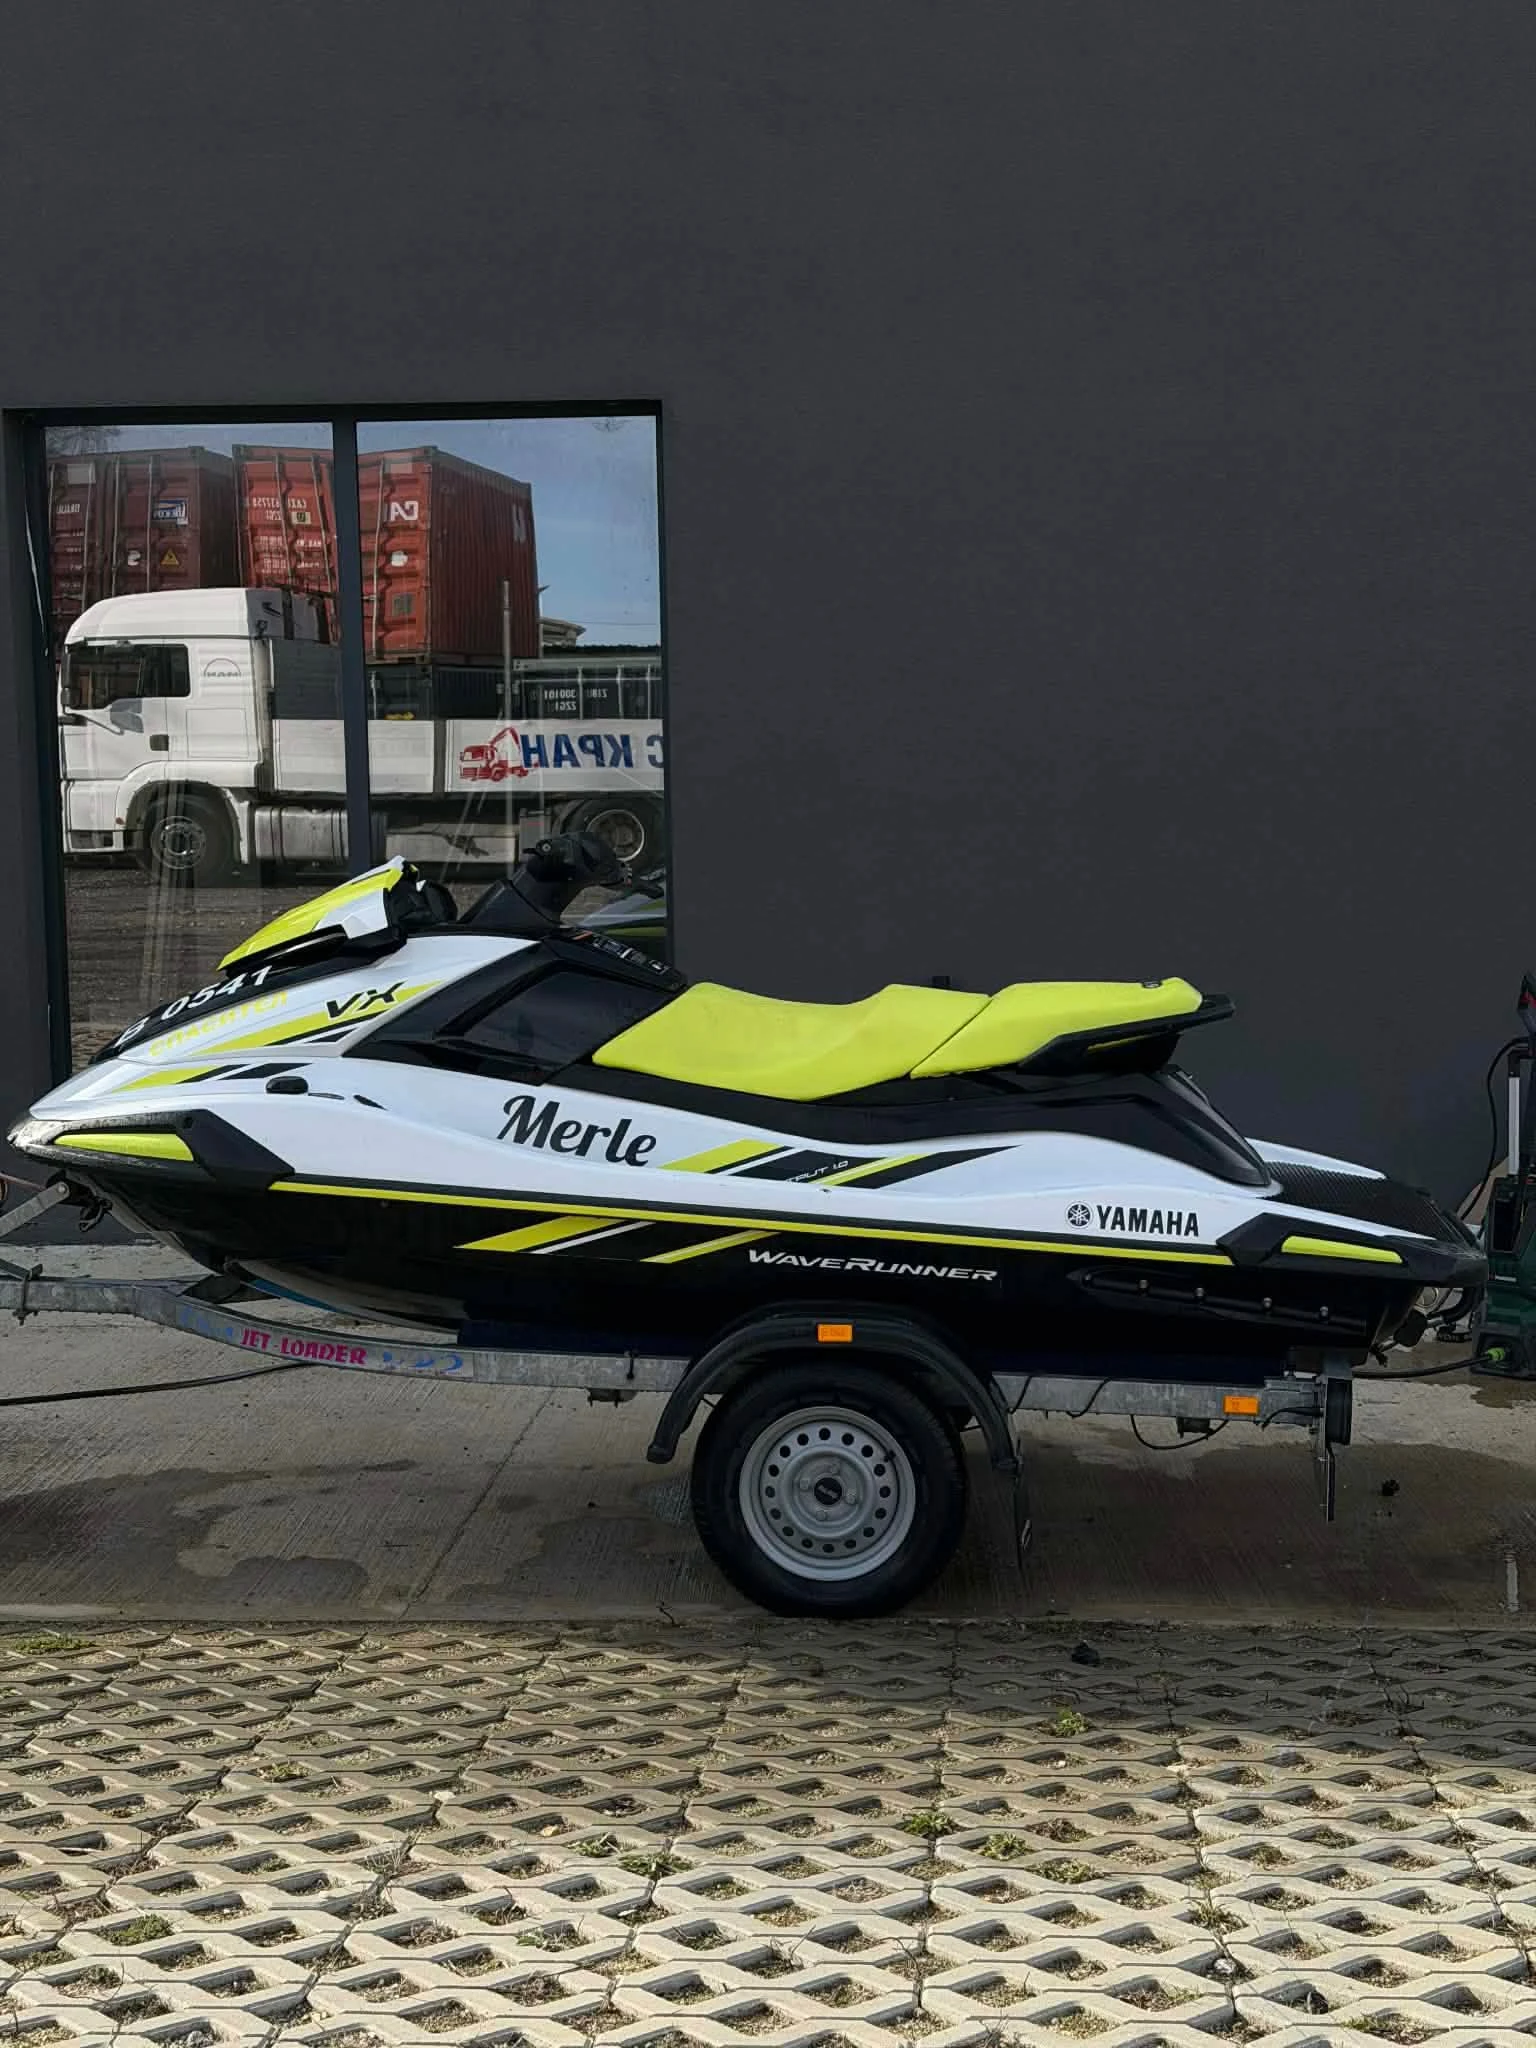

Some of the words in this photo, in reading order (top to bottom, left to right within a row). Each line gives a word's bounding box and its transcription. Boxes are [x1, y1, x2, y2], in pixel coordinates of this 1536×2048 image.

[160, 965, 273, 1020] 0541
[325, 979, 408, 1019] VX
[497, 1094, 657, 1167] Merle
[1097, 1204, 1200, 1238] YAMAHA
